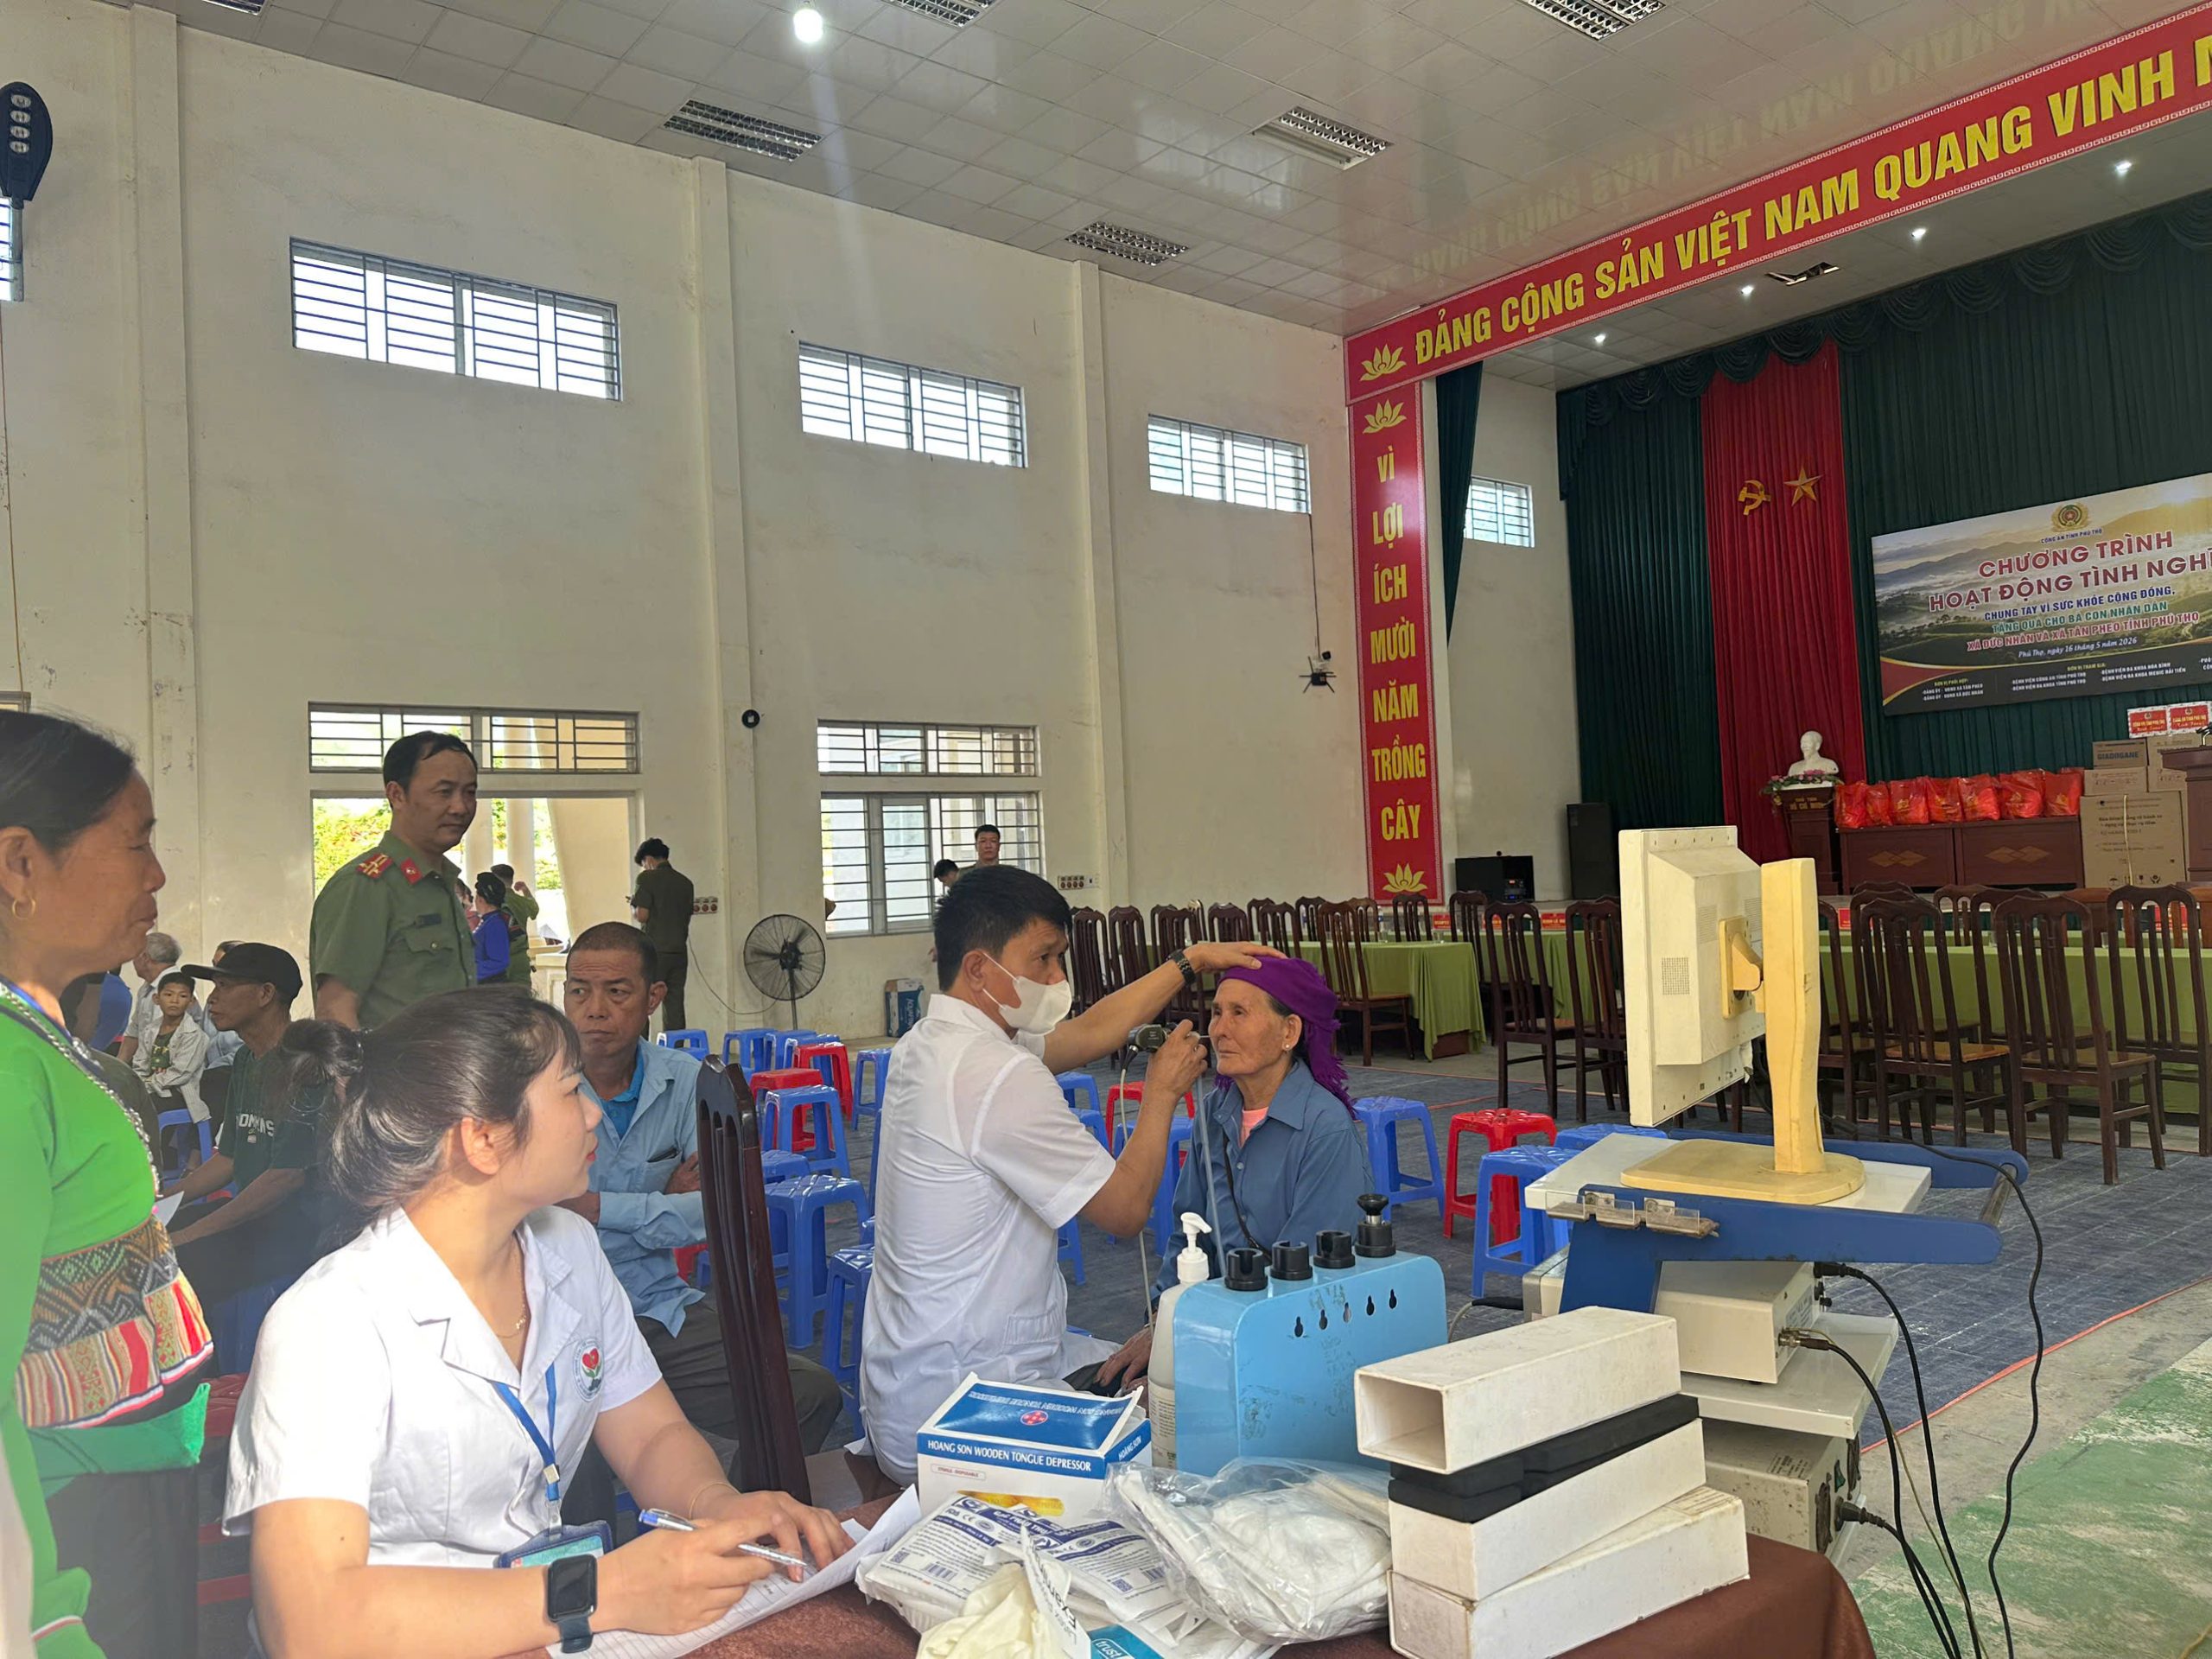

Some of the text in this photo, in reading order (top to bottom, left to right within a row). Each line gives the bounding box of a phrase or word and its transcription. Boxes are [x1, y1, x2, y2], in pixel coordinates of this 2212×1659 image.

[1415, 308, 1491, 365] ĐẢNG
[1501, 273, 1584, 334] CỘNG
[1595, 237, 1664, 299] SẢN
[1675, 209, 1751, 267] VIỆT
[1764, 168, 1859, 240] NAM
[1874, 105, 2032, 201] QUANG
[2047, 49, 2175, 137] VINH
[1979, 531, 2172, 578] CHƯƠNG TRÌNH
[1929, 587, 1992, 612] HOẠT
[1999, 575, 2073, 601] ĐỘNG
[2080, 564, 2138, 588] TÌNH
[1985, 608, 2018, 621] CHUNG
[2022, 606, 2037, 616] TAY
[2053, 599, 2073, 612] SỨC
[2107, 590, 2137, 604] CỘNG
[2045, 615, 2065, 627] CHO
[2085, 610, 2107, 621] CON
[1370, 446, 1427, 841] VÌ LỢI ÍCH MƯỜI NĂM TRỒNG CÂY
[2091, 621, 2120, 635] PHEO
[2074, 641, 2094, 652] tháng
[2119, 636, 2138, 646] 2026
[928, 1440, 1091, 1472] HOANG SON WOODEN TONGUE DEPRESSOR
[1096, 1641, 1122, 1658] trust
